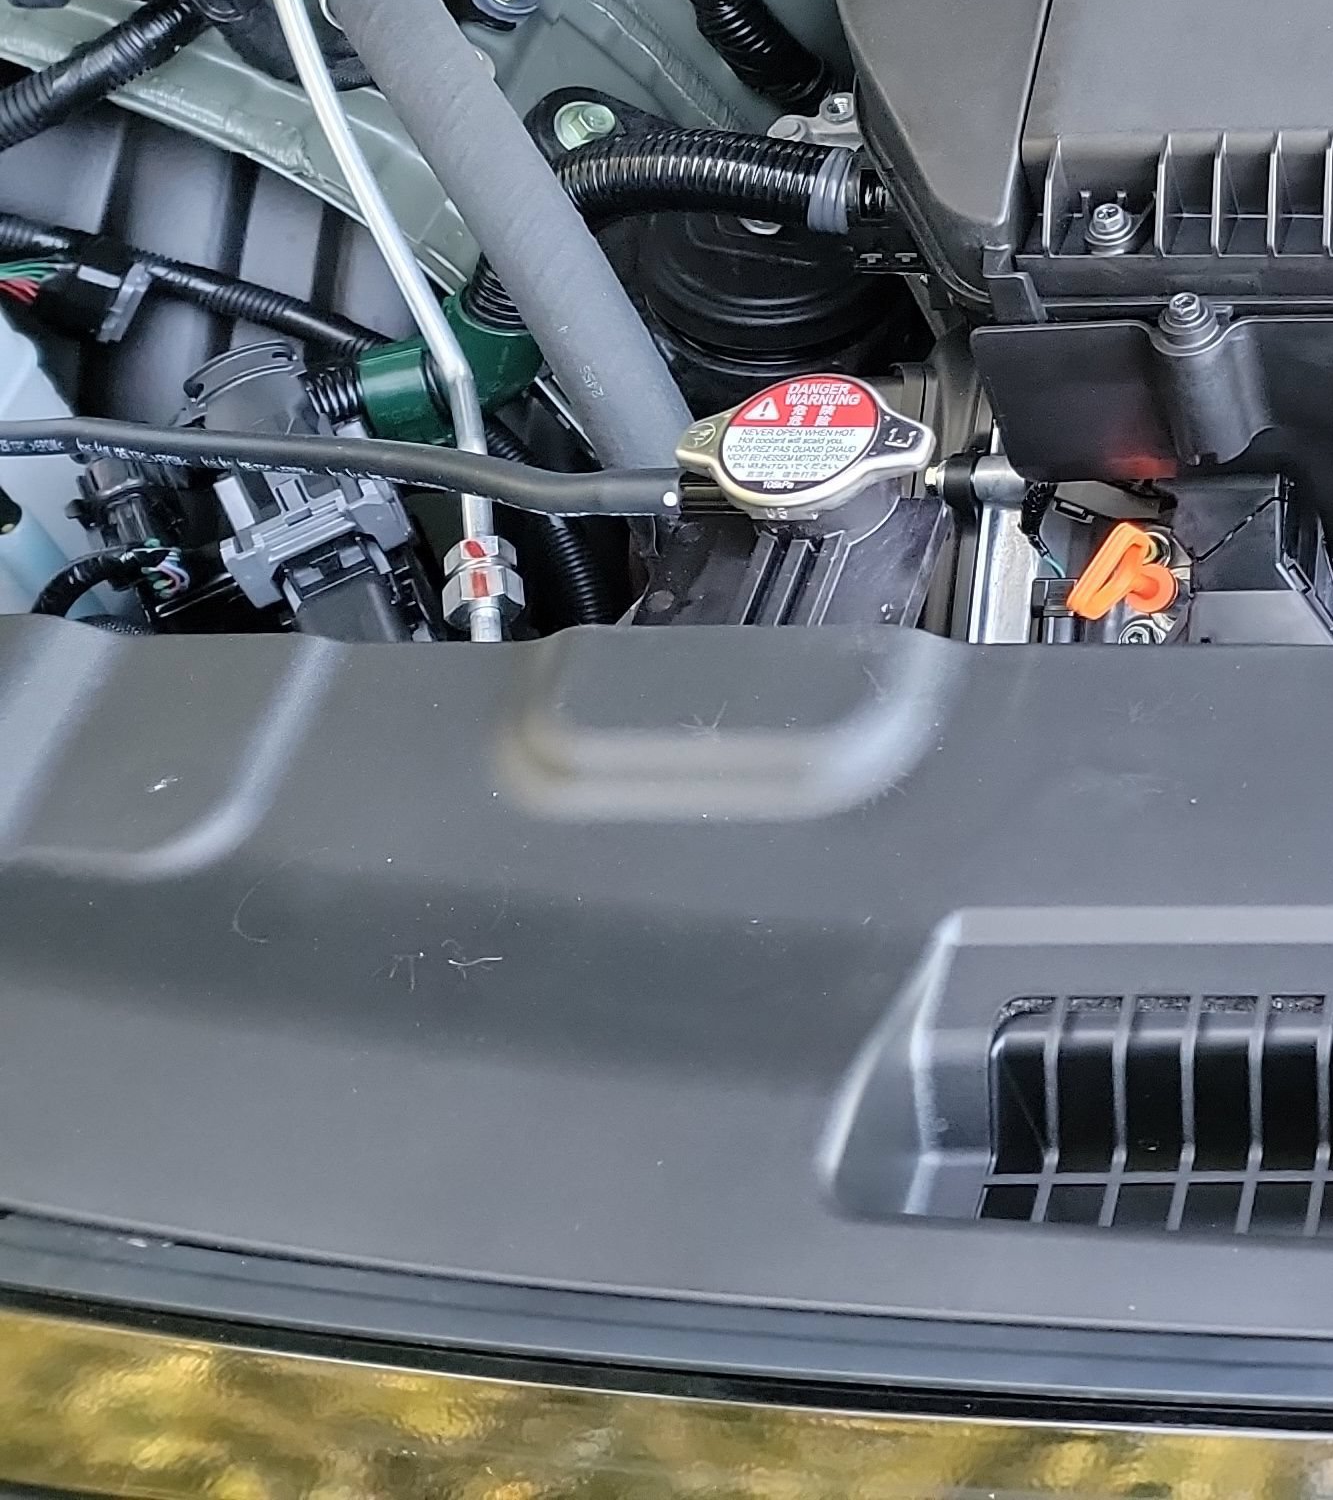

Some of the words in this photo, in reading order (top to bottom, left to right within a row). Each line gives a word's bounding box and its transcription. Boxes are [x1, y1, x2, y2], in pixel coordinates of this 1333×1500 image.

[788, 383, 851, 395] DANGER
[785, 394, 861, 406] WARNUNG
[835, 429, 856, 437] HOT.
[792, 445, 823, 453] QUAND
